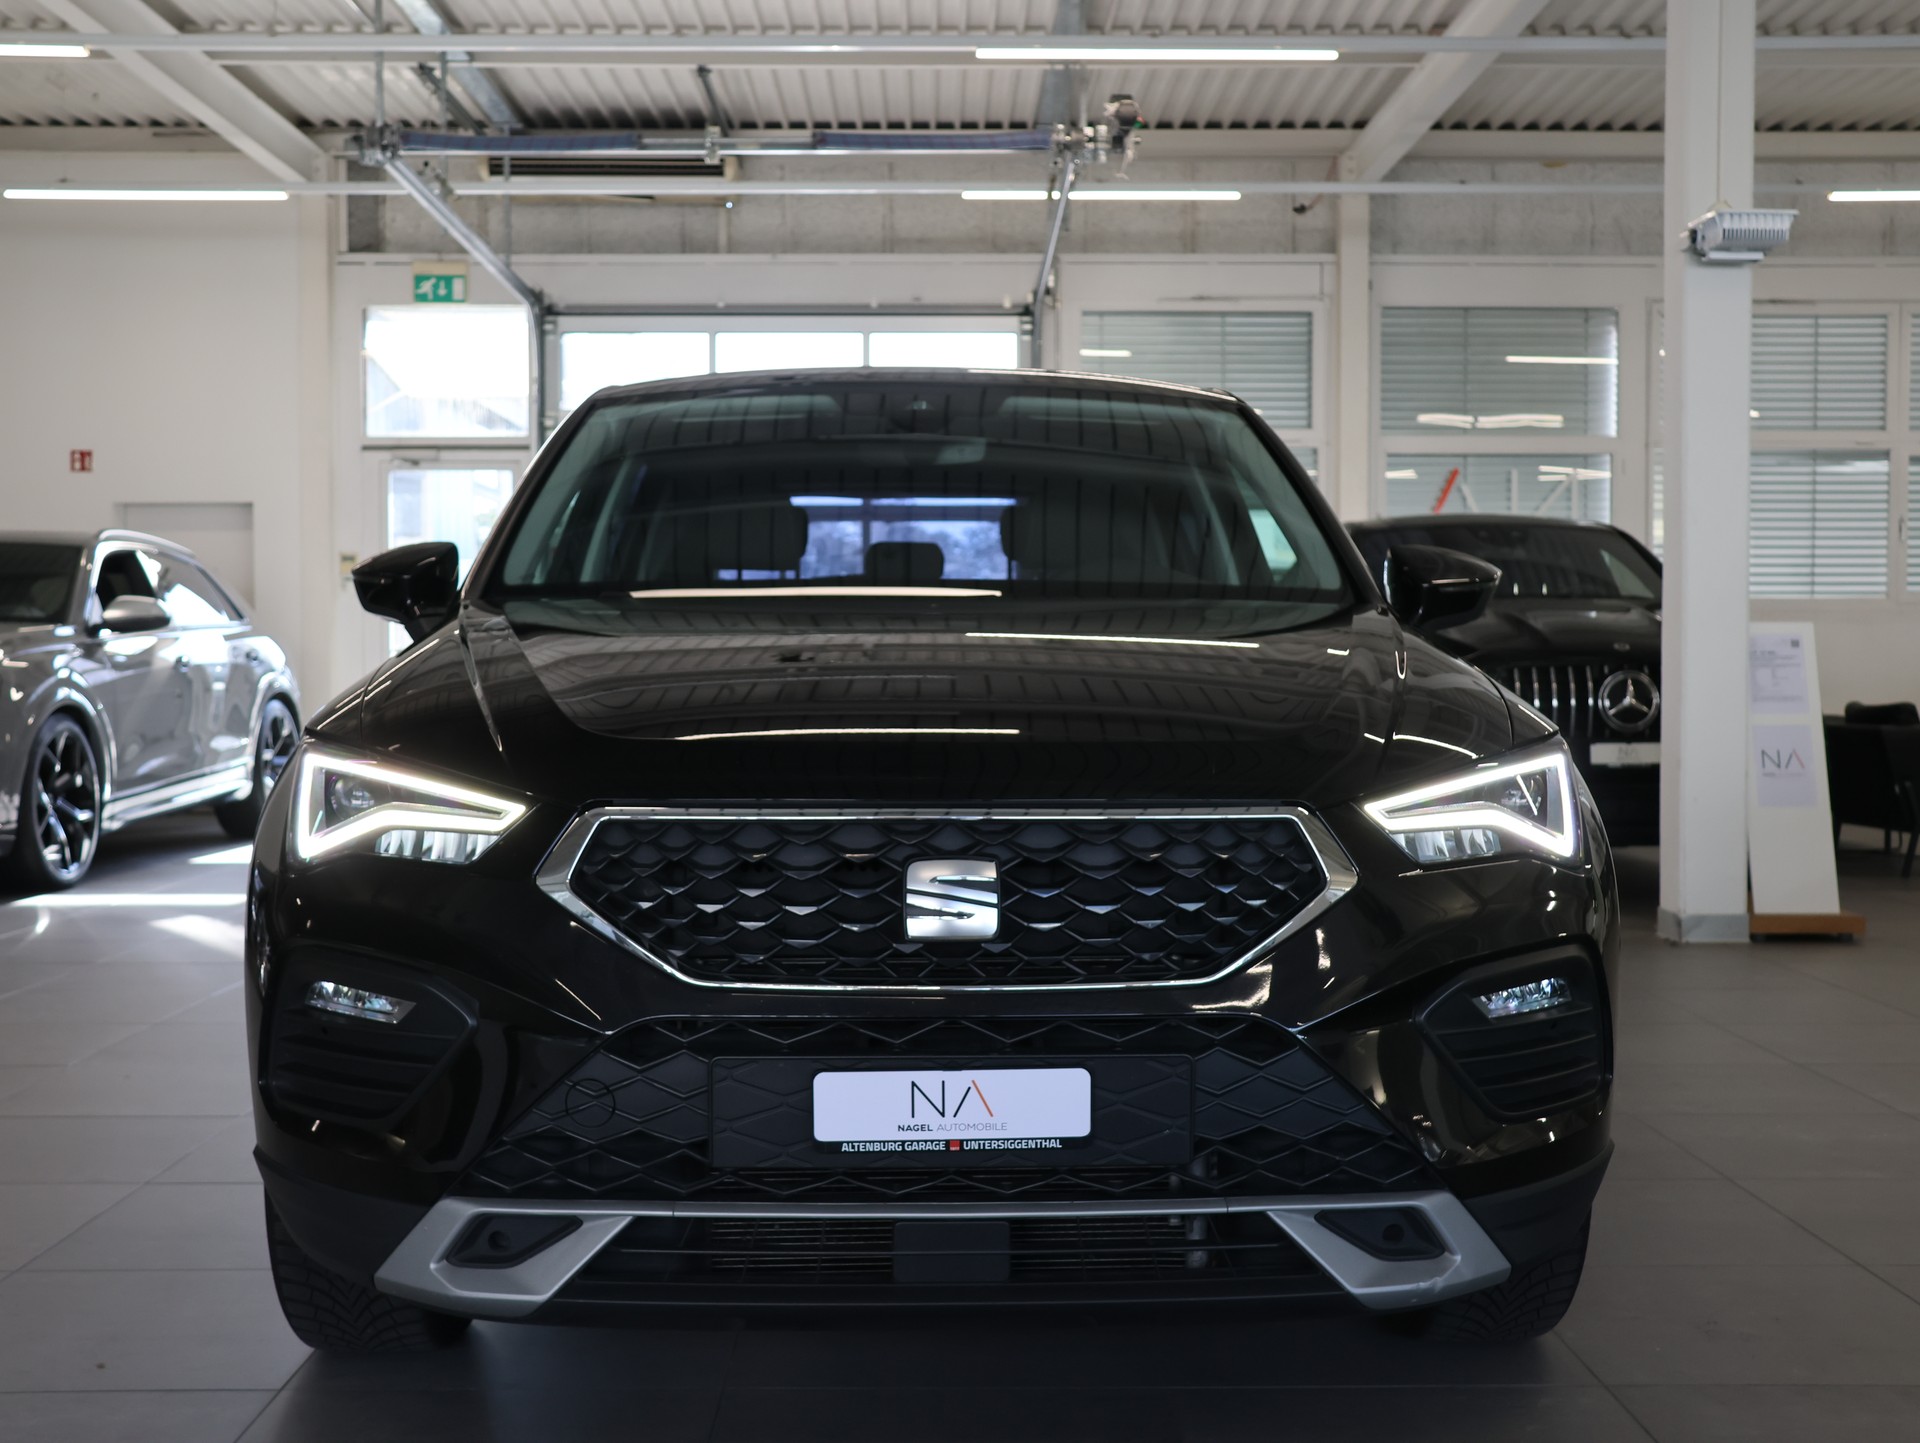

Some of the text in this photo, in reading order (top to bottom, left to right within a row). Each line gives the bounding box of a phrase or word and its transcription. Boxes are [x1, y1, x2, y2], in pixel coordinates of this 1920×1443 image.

[910, 1079, 994, 1119] NA
[897, 1122, 1008, 1132] NAGEL AUTOMOBILE
[841, 1138, 1063, 1152] ALTENBURG GARAGE UNTERSIGGENTHAL
